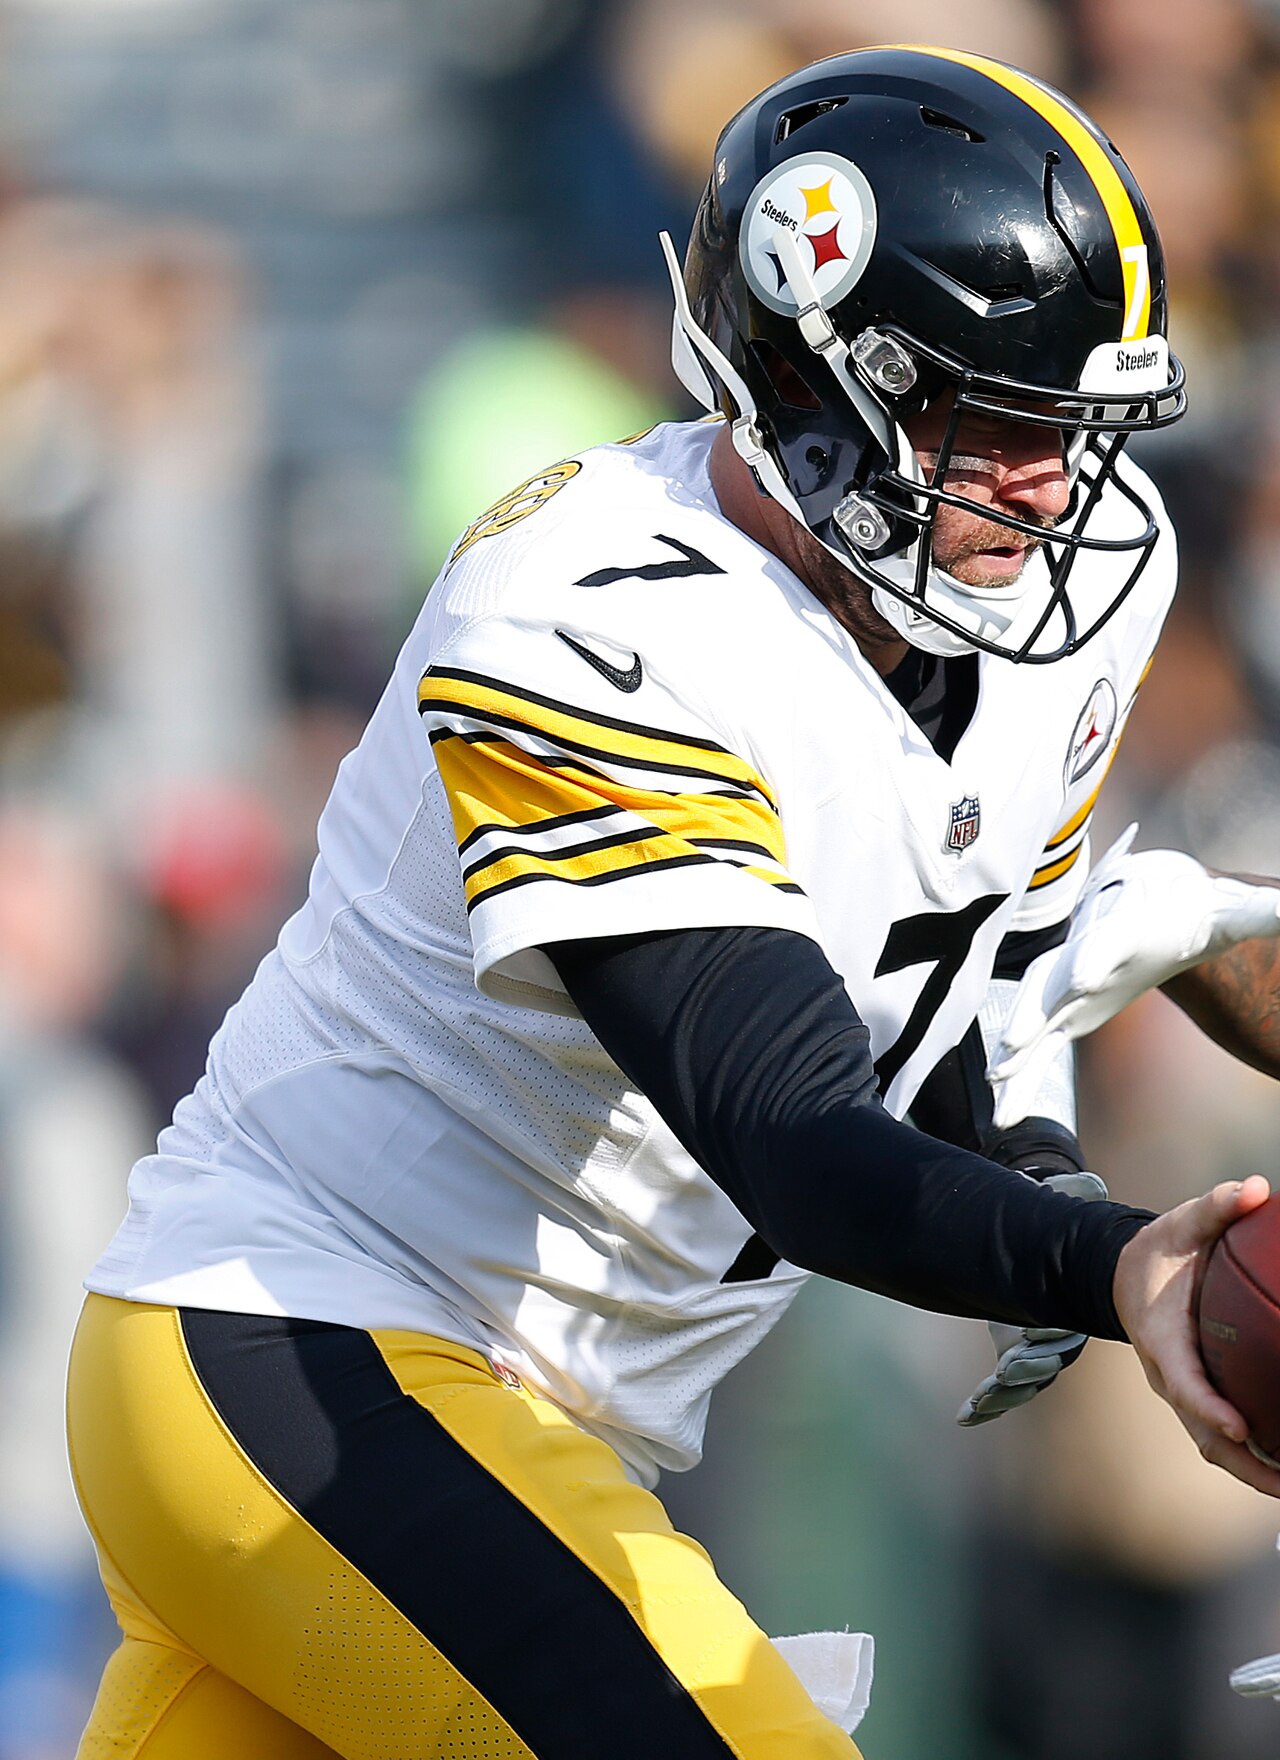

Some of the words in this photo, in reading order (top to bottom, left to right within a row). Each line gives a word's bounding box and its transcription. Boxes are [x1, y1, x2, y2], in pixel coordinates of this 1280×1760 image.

[761, 199, 798, 232] Steelers
[1122, 244, 1148, 338] 7
[1116, 347, 1159, 372] Steelers
[571, 533, 729, 587] 7
[950, 820, 977, 846] NFL
